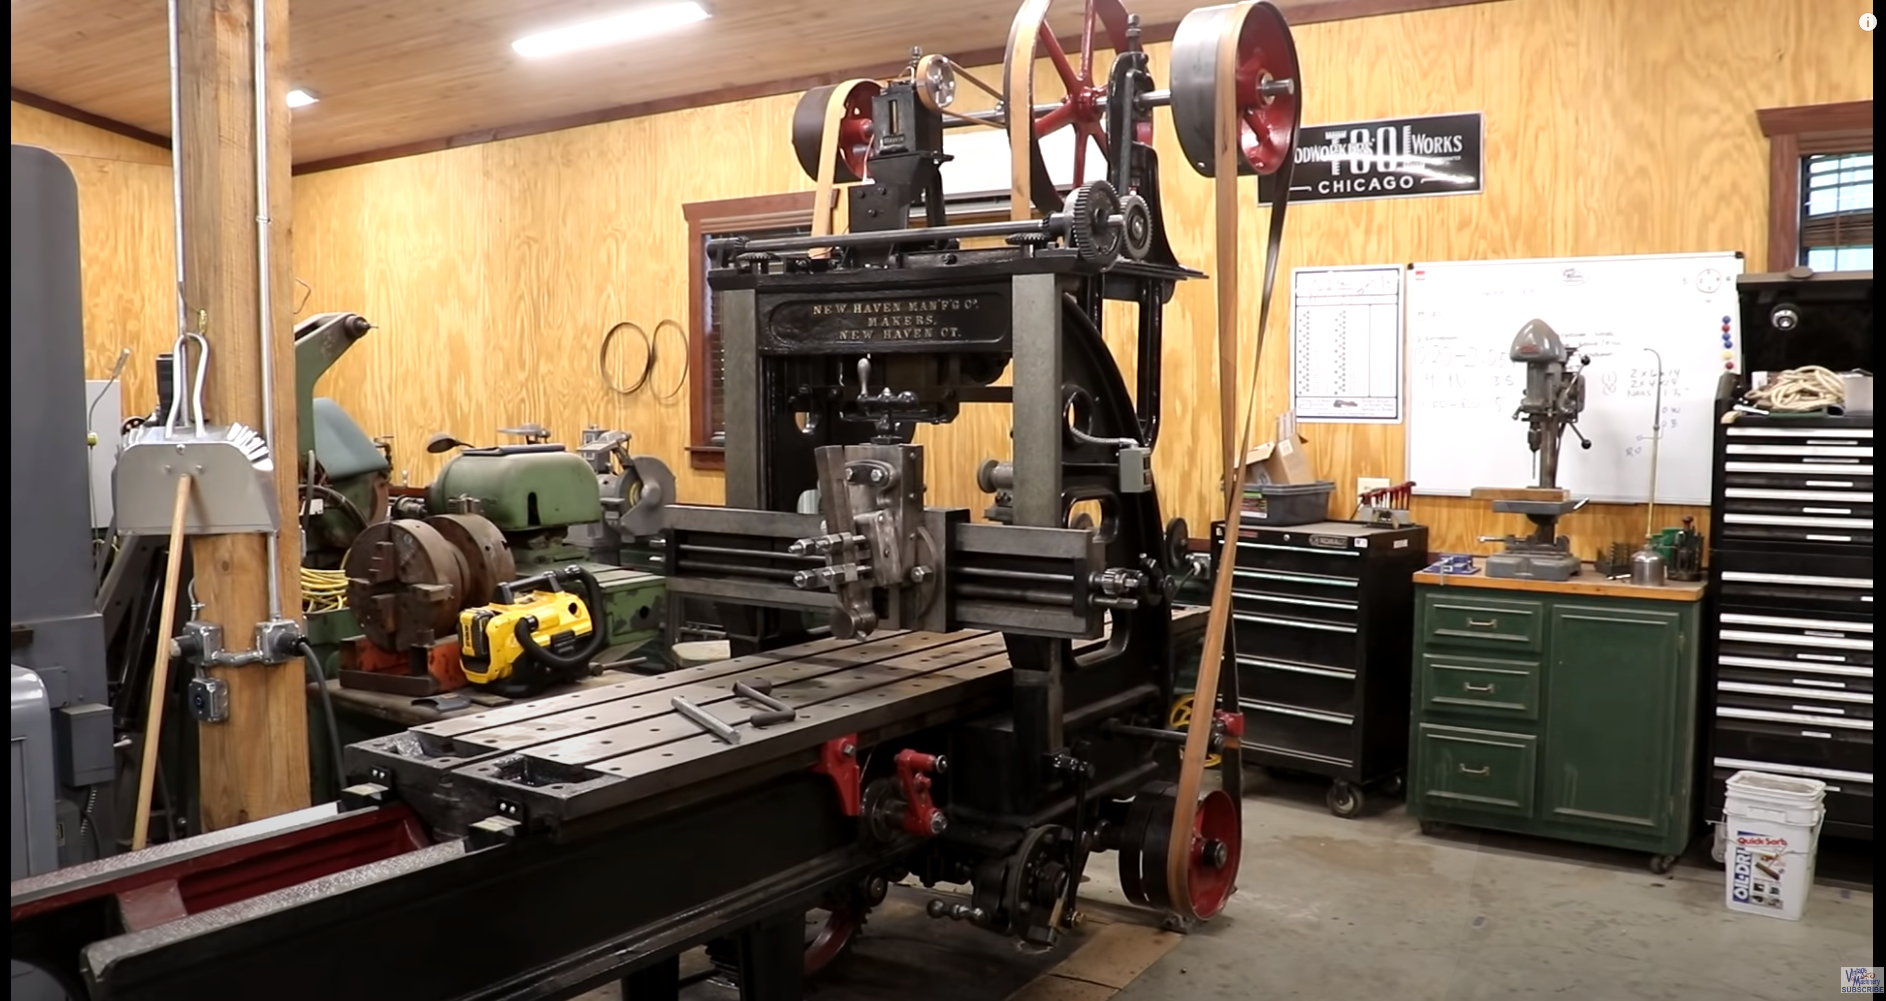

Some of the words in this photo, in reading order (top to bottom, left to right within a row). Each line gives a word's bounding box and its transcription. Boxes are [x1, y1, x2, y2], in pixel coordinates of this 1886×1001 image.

[1317, 175, 1415, 195] CHICAGO
[812, 303, 847, 316] NEW
[852, 301, 901, 315] HAVEN
[867, 315, 937, 328] MAKERS.
[839, 329, 874, 341] NEW
[882, 328, 934, 340] HAVEN
